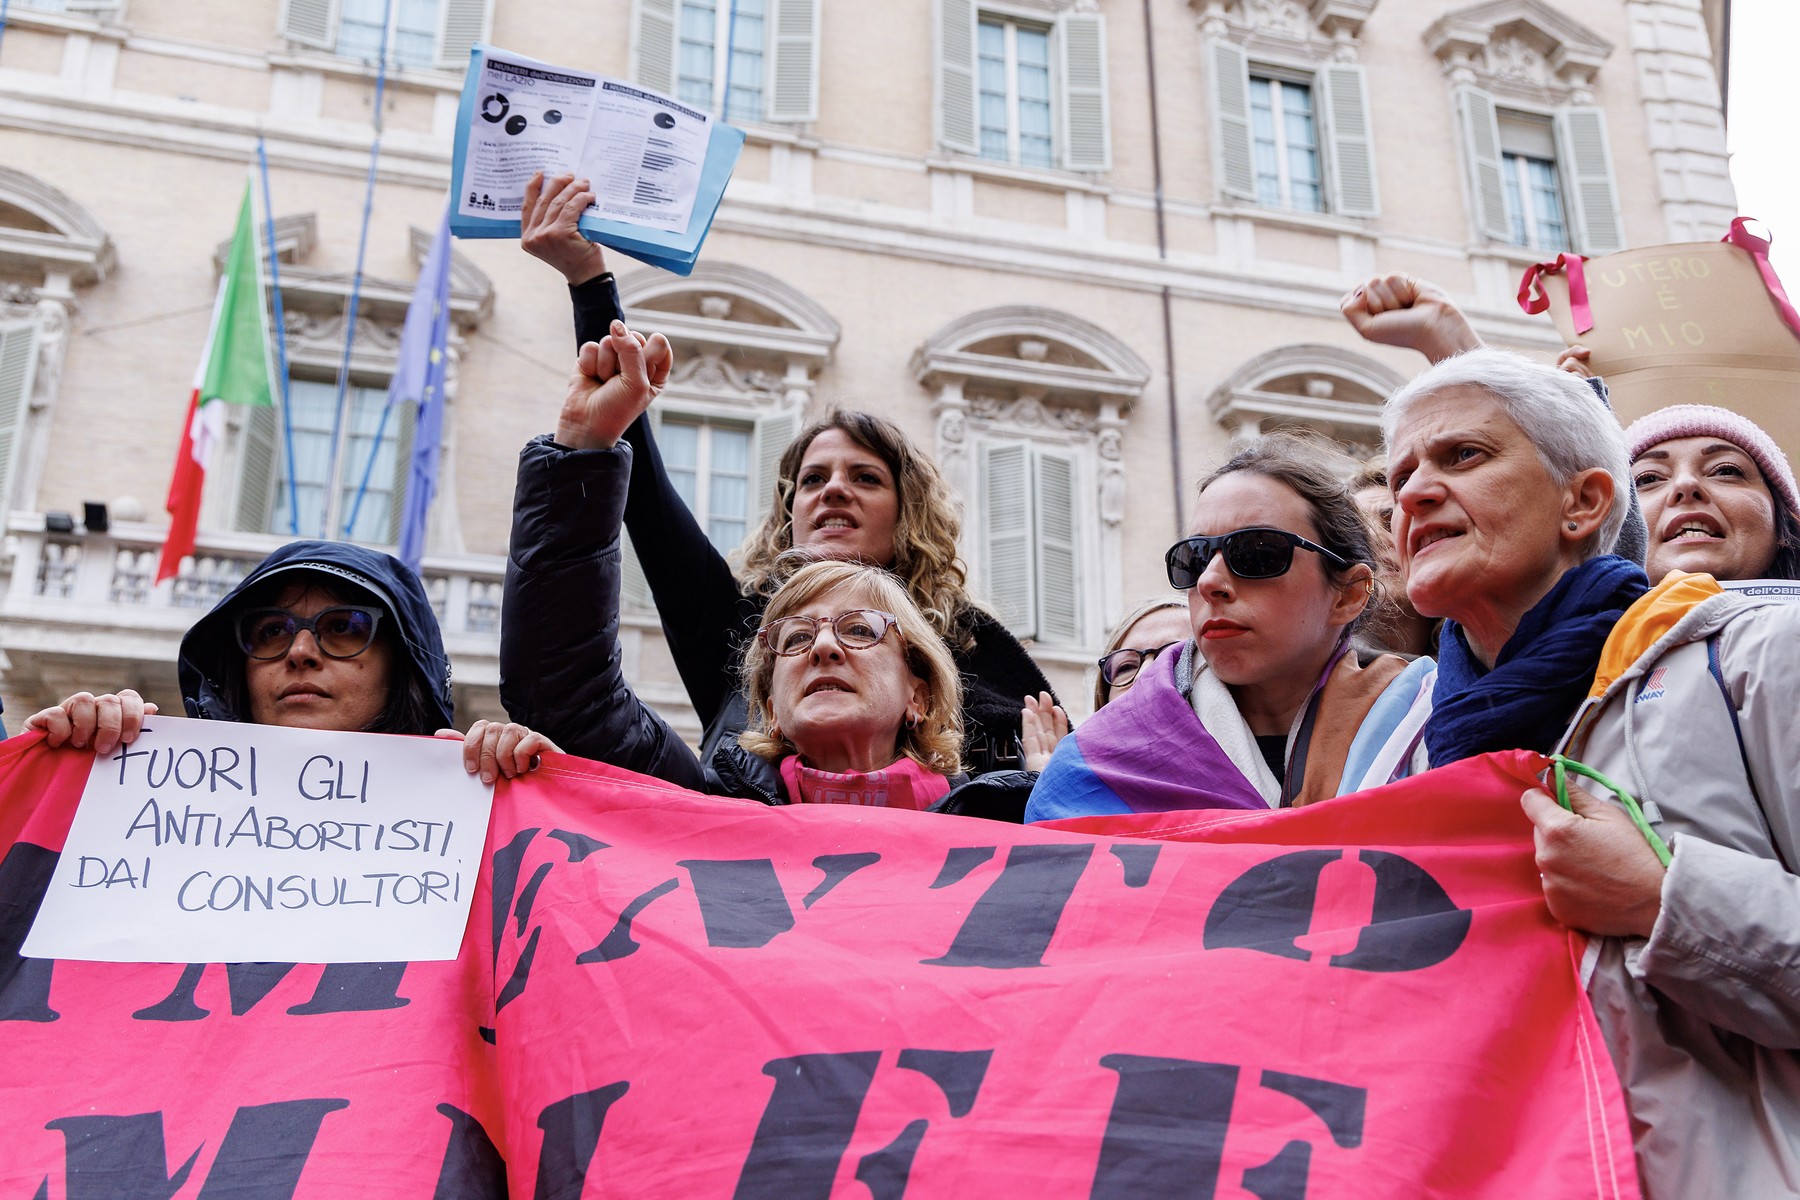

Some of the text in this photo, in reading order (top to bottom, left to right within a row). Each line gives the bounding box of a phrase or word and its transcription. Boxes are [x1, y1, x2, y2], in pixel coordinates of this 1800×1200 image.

[487, 70, 503, 80] nel
[505, 73, 535, 87] LAZIO
[494, 61, 528, 77] NUMERI
[530, 70, 593, 87] dell'OBIEZIONE
[1621, 322, 1705, 349] MIO
[113, 728, 369, 803] FUORI GLI
[125, 798, 454, 857] ANTIABORTISTI
[68, 856, 151, 889] DAI
